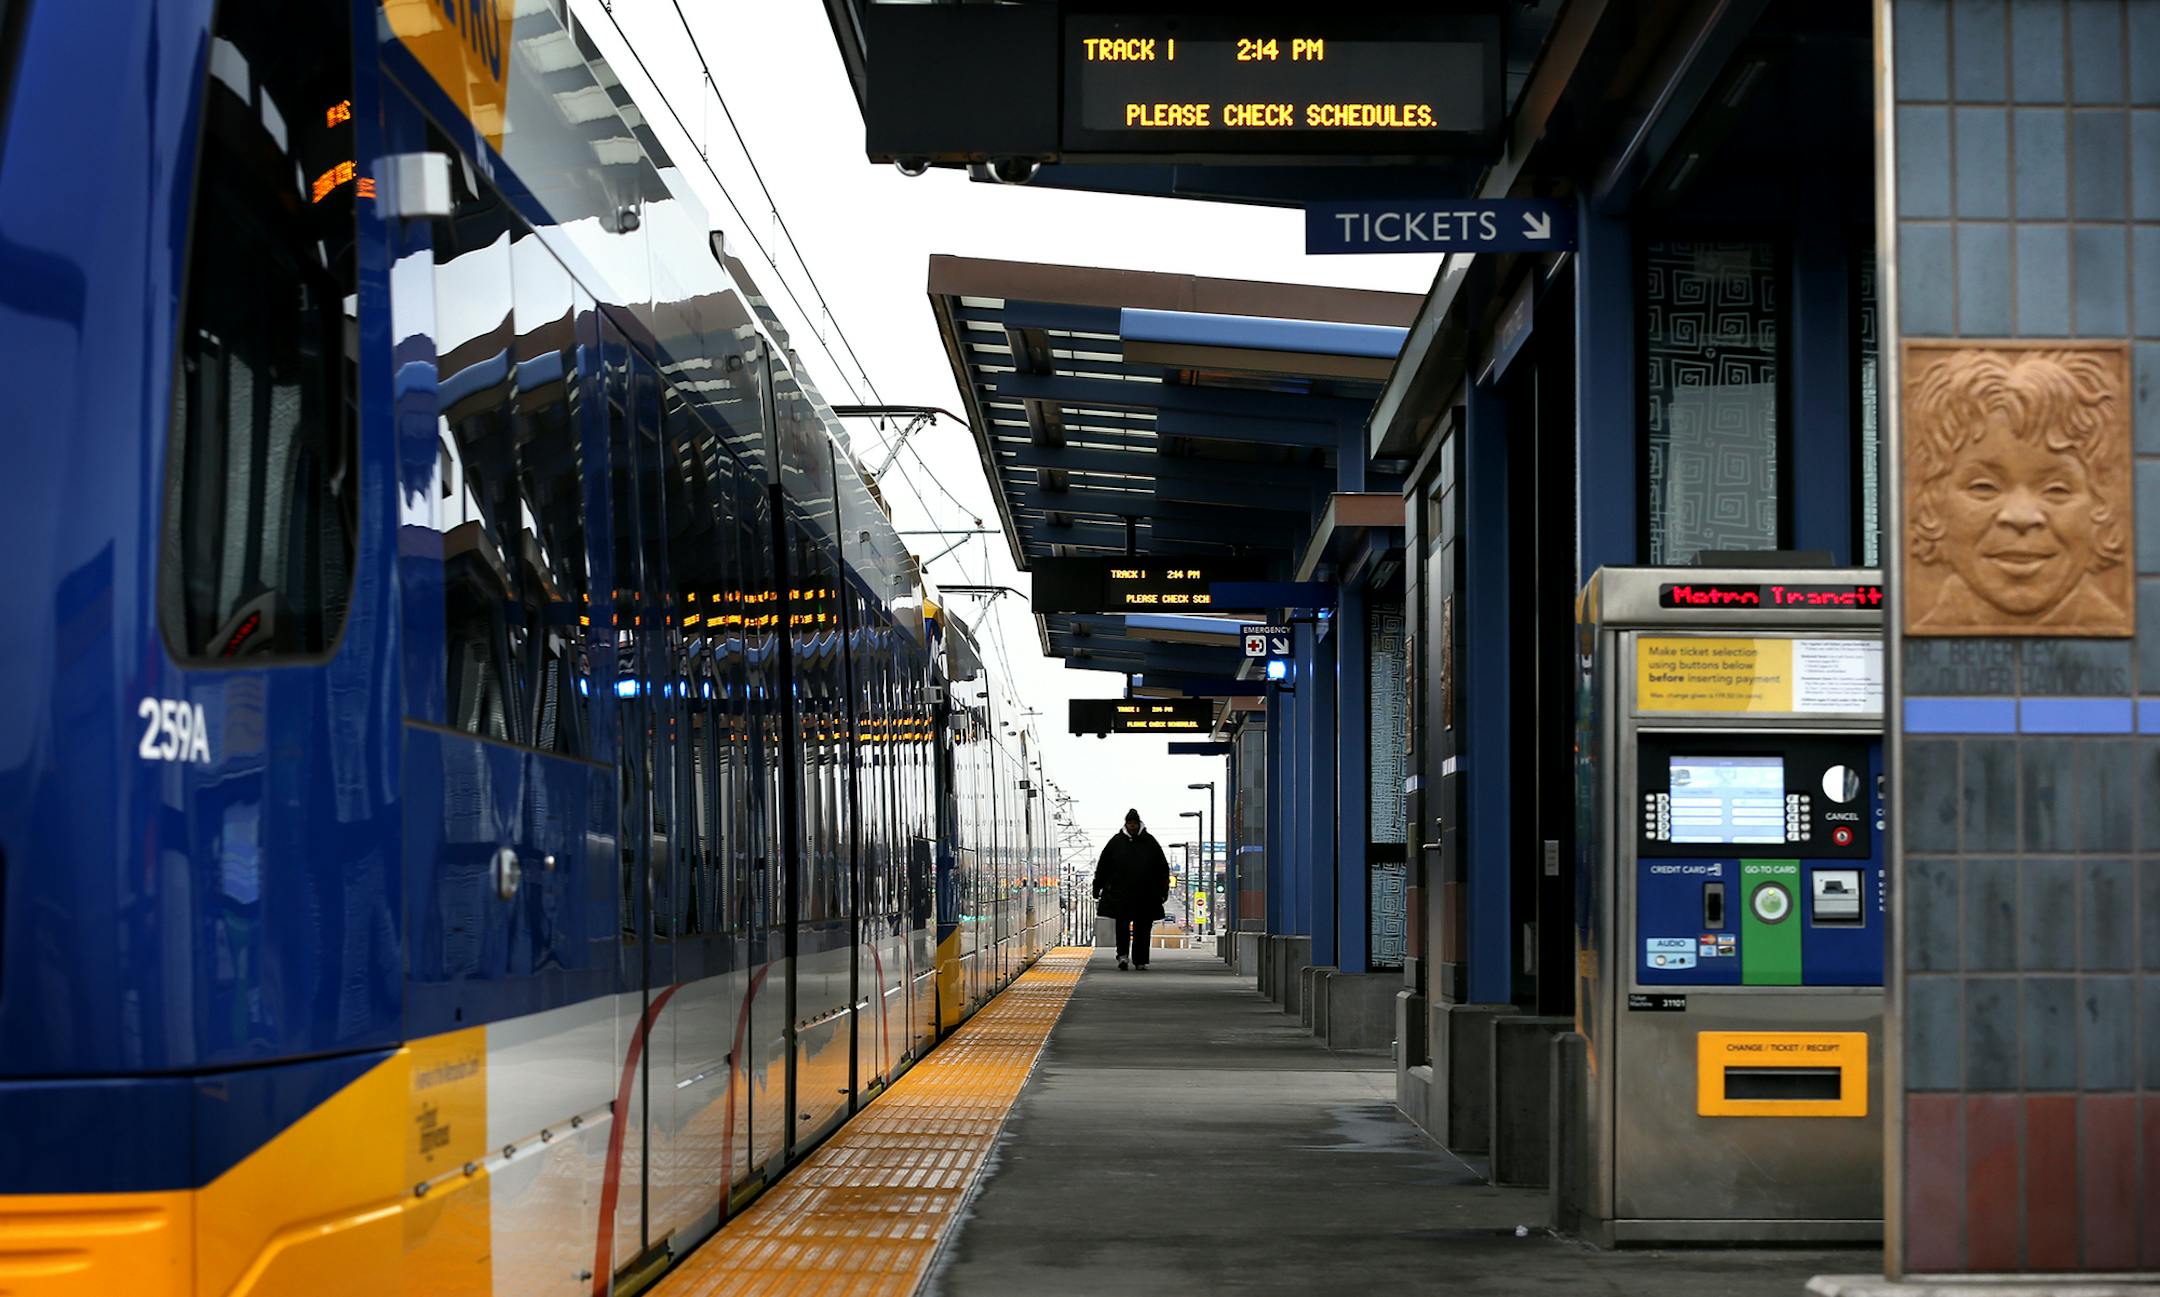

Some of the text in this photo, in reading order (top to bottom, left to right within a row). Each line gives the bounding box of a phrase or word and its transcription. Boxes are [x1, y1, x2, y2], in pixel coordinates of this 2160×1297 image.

[1083, 38, 1156, 61] TRACK
[1236, 38, 1280, 62] 2:14
[1292, 38, 1324, 61] PM
[1126, 103, 1438, 128] PLEASE CHECK SCHEDULES.
[1336, 211, 1497, 243] TICKETS
[1111, 569, 1138, 579] TRACK
[1187, 569, 1201, 579] PM
[1126, 594, 1158, 604] PLEASE
[1161, 594, 1189, 604] CHECK
[1243, 626, 1292, 634] EMERGENCY
[1648, 646, 1758, 656] Make ticket selection
[1648, 660, 1754, 672] using buttons below
[1648, 672, 1781, 686] before inserting payment
[138, 697, 211, 764] 259A
[1825, 812, 1859, 821] CANCEL
[1650, 865, 1706, 874] CREDIT CARD
[1744, 865, 1797, 874] GO-TO CARD
[1657, 940, 1686, 948] AUDIO
[1726, 1043, 1763, 1052] CHANGE
[1770, 1043, 1800, 1052] TICKET
[1806, 1043, 1840, 1052] RECEIPT
